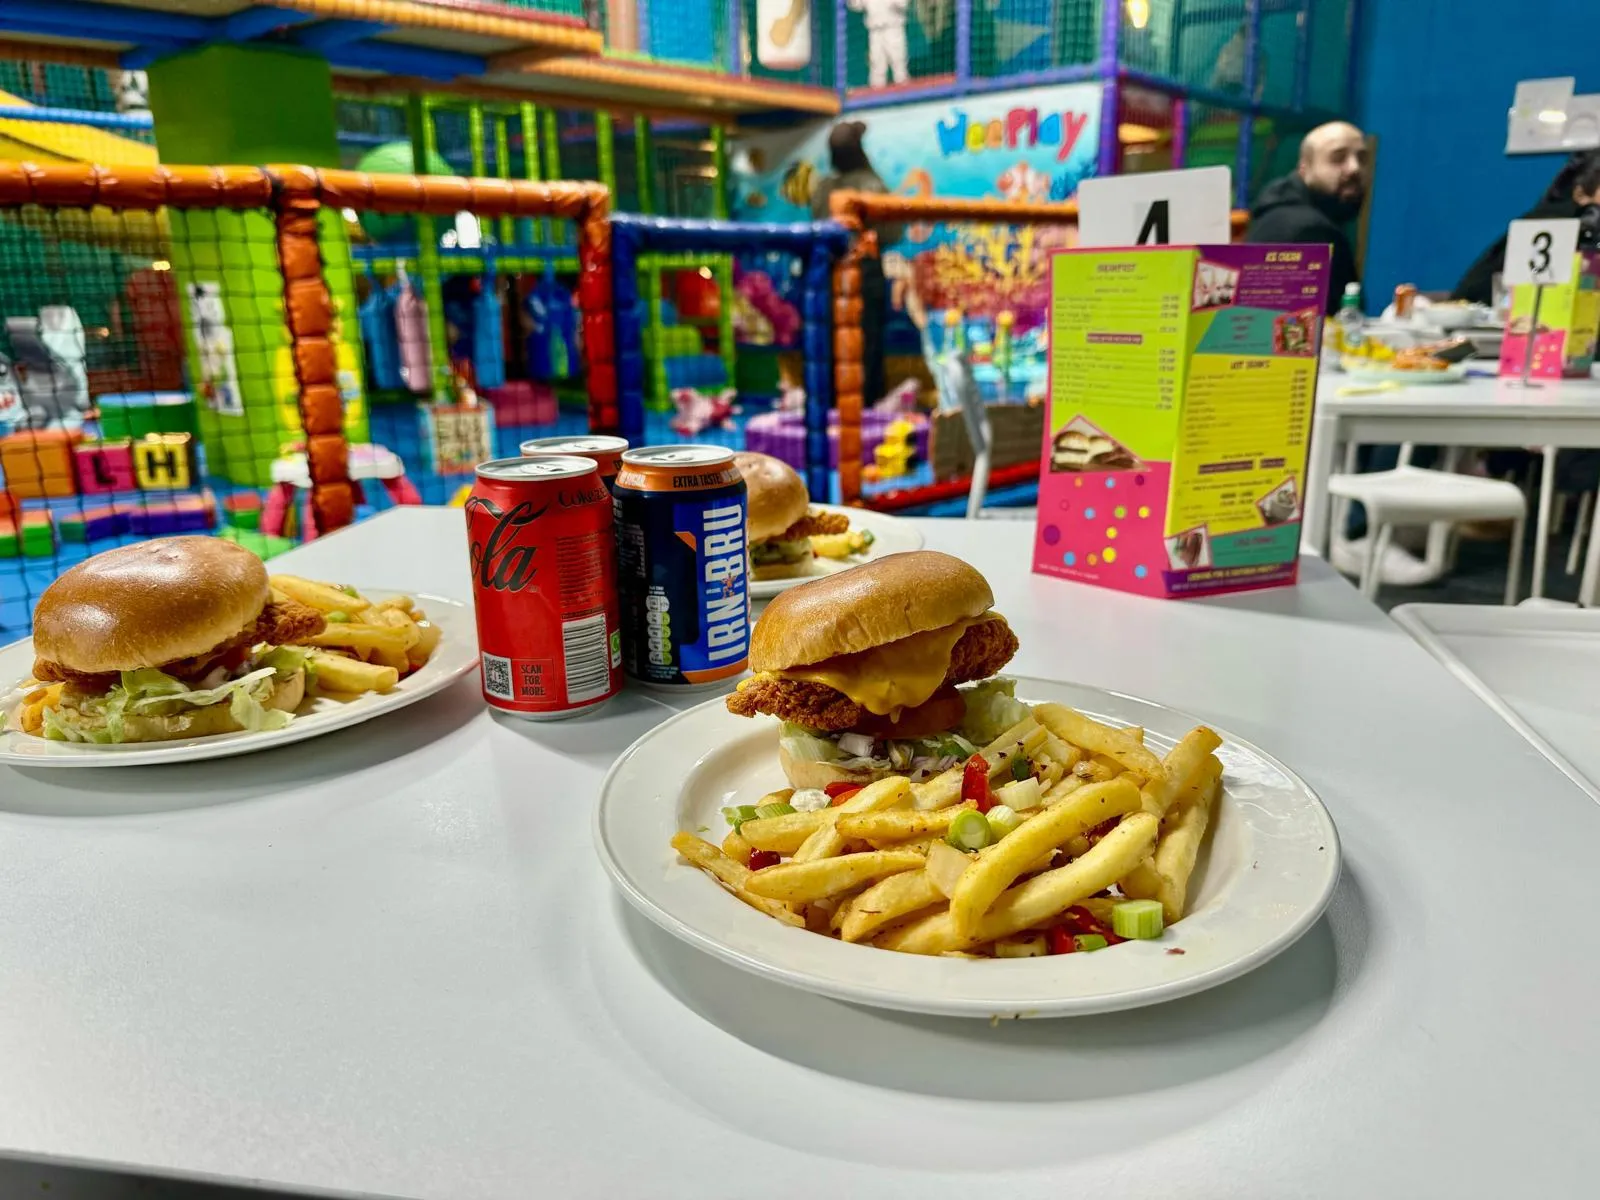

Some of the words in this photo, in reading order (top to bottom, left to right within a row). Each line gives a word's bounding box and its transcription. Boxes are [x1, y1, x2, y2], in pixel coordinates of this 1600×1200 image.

[1529, 232, 1552, 273] 3
[92, 454, 117, 484] L
[146, 450, 177, 479] H
[673, 475, 698, 488] EXTRA
[521, 664, 542, 675] SCAN
[523, 675, 541, 686] FOR
[521, 686, 546, 697] MORE
